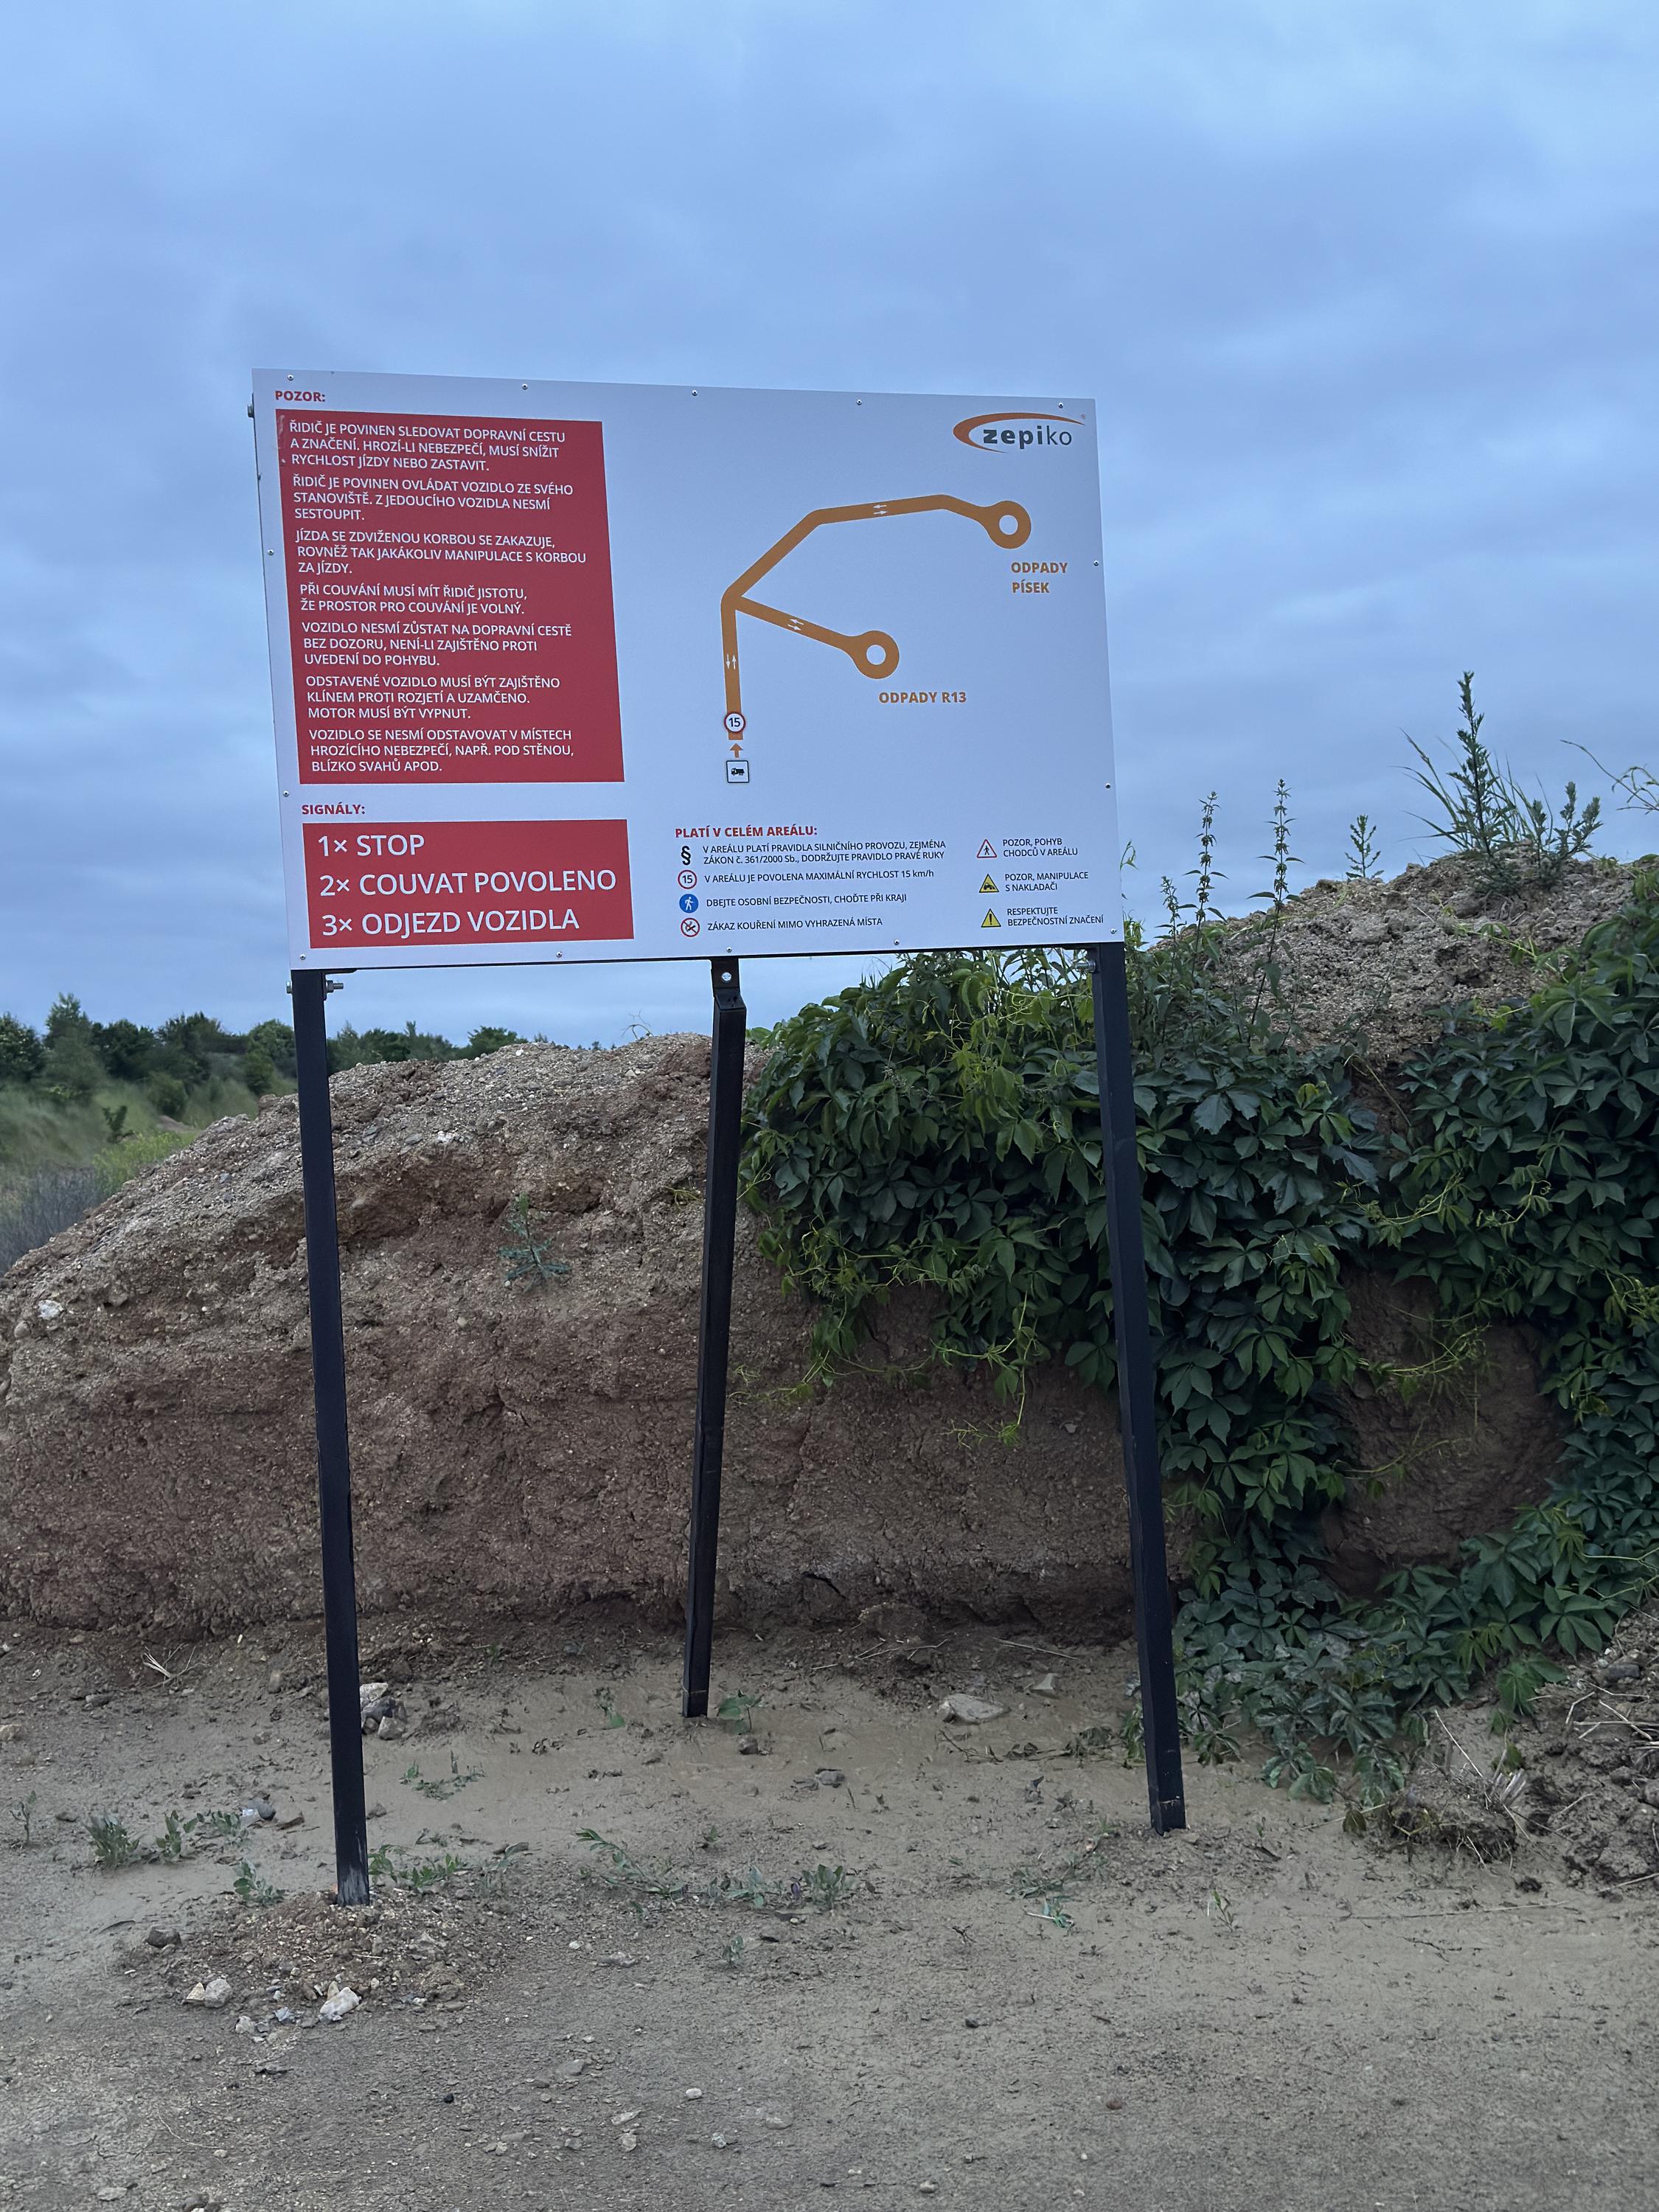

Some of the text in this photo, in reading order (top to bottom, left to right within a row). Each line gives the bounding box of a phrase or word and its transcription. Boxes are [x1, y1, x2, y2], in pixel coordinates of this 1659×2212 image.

[275, 390, 325, 403] POZOR:
[290, 419, 565, 442] ŘIDIČ JE POVINEN SLEDOVAT DOPRAVNÍ CESTU
[983, 425, 1072, 449] zepiko
[291, 437, 559, 458] A ZNAČENÍ. HROZÍ-LI NEBEZPEČÍ, MUSÍ SNÍŽIT
[292, 453, 490, 471] RYCHLOST JÍZDY NEBO ZASTAVIT.
[293, 473, 573, 495] ŘIDIČ JE POVINEN OVLÁDAT VOZIDLO ZE SVÉHO
[293, 490, 550, 510] STANOVIŠTĚ. Z JEDOUCÍHO VOZIDLA NESMÍ
[295, 508, 365, 521] SESTOUPIT.
[295, 527, 555, 549] JÍZDA SE ZDVIŽENOU KORBOU SE ZAKAZUJE,
[298, 560, 352, 576] ZA JÍZDY.
[1011, 562, 1068, 574] ODPADY
[300, 582, 527, 600] PŘI COUVÁNÍ MUSÍ MÍT ŘIDIČ JISTOTU,
[1012, 579, 1050, 594] PÍSEK
[300, 597, 524, 616] ŽE PROSTOR PRO COUVÁNÍ JE VOLNÝ.
[302, 621, 571, 636] VOZIDLO NESMÍ ZŮSTAT NA DOPRAVNÍ CESTĚ
[306, 673, 560, 690] ODSTAVENÉ VOZIDLO MUSÍ BÝT ZAJIŠTĚNO
[307, 689, 530, 705] KLÍNEM PROTI ROZJETÍ A UZAMČENO.
[879, 692, 967, 703] ODPADY R13
[308, 705, 471, 719] MOTOR MUSÍ BÝT VYPNUT.
[728, 717, 741, 727] 15
[309, 727, 571, 740] VOZIDLO SE NESMÍ ODSTAVOVAT V MÍSTECH
[310, 742, 574, 757] HROZÍCÍHO NEBEZPEČÍ, NAPŘ. POD STĚNOU,
[312, 757, 442, 772] BLÍZKO SVAHŮ APOD.
[302, 801, 365, 815] SIGNÁLY:
[675, 826, 818, 838] PLATÍ V CELÉM AREÁLU:
[357, 834, 425, 856] STOP
[703, 841, 946, 854] V AREÁLU PLATÍ PRAVIDLA SILNIČNÍHO PROVOZU, ZEJMÉNA
[1003, 838, 1062, 847] POZOR, POHYB
[703, 855, 734, 865] ZÁKON
[736, 855, 743, 864] č.
[745, 855, 783, 864] 361/2000
[801, 853, 849, 863] DODRŽUJTE
[851, 852, 893, 861] PRAVIDLO
[894, 852, 921, 860] PRAVÉ
[922, 851, 945, 859] RUKY
[1003, 846, 1038, 858] CHODCŮ
[1047, 846, 1078, 856] AREÁLU
[359, 872, 468, 895] COUVAT
[475, 869, 616, 893] POVOLENO
[682, 874, 693, 884] 15
[704, 869, 934, 884] V AREÁLU JE POVOLENA MAXIMÁLNÍ RYCHLOST 15 km/h
[1005, 872, 1088, 881] POZOR, MANIPULACE
[1005, 881, 1057, 892] S NAKLADAČI
[706, 893, 907, 908] DBEJTE OSOBNÍ BEZPEČNOSTI, CHOĎTE PŘI KRAJI
[1006, 907, 1058, 917] RESPEKTUJTE
[362, 911, 461, 939] ODJEZD
[467, 908, 580, 932] VOZIDLA
[707, 917, 883, 931] ZÁKAZ KOUŘENÍ MIMO VYHRAZENÁ MÍSTA
[1007, 914, 1104, 926] BEZPEČNOSTNÍ ZNAČENÍ
